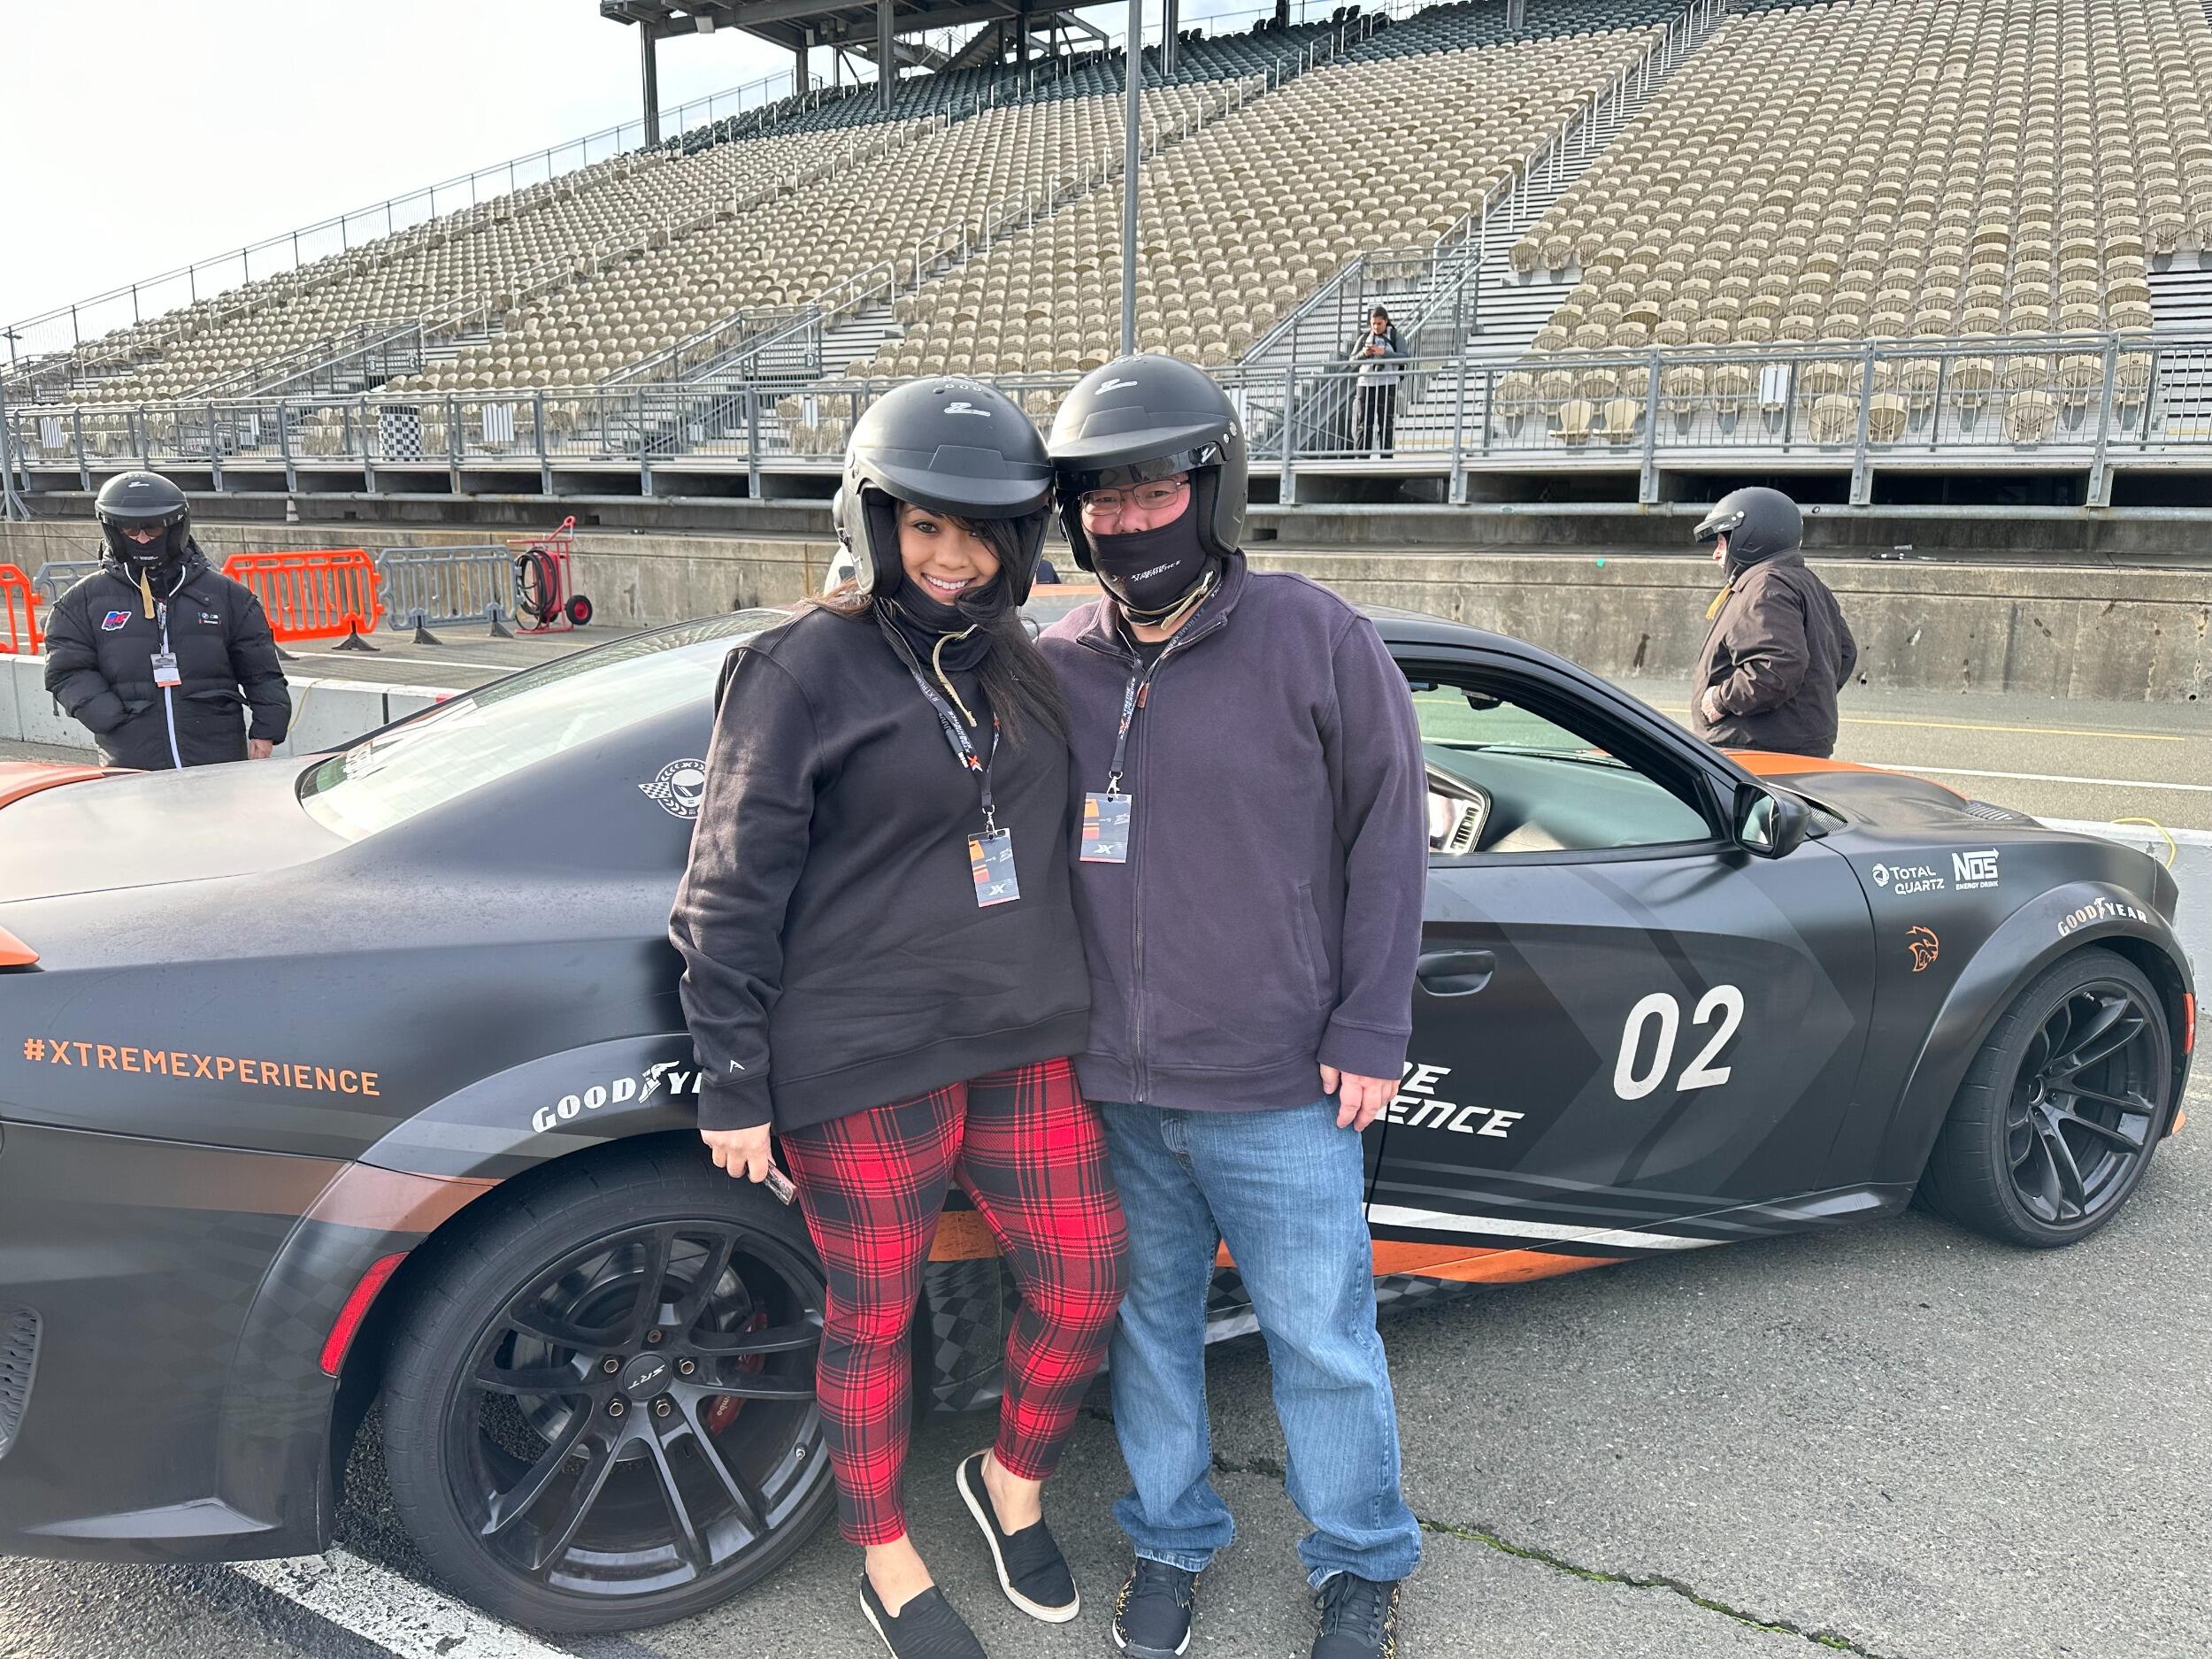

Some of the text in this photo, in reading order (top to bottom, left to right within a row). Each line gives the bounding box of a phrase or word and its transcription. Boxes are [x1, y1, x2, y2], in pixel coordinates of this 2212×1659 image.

[807, 354, 814, 366] D
[1889, 865, 1937, 880] TOTAL
[1951, 847, 2000, 881] NOS
[1894, 878, 1945, 895] QUARTZ
[1613, 984, 1745, 1101] 02
[24, 1038, 380, 1096] #XTREMEXPERIENCE
[627, 1364, 665, 1390] SRT
